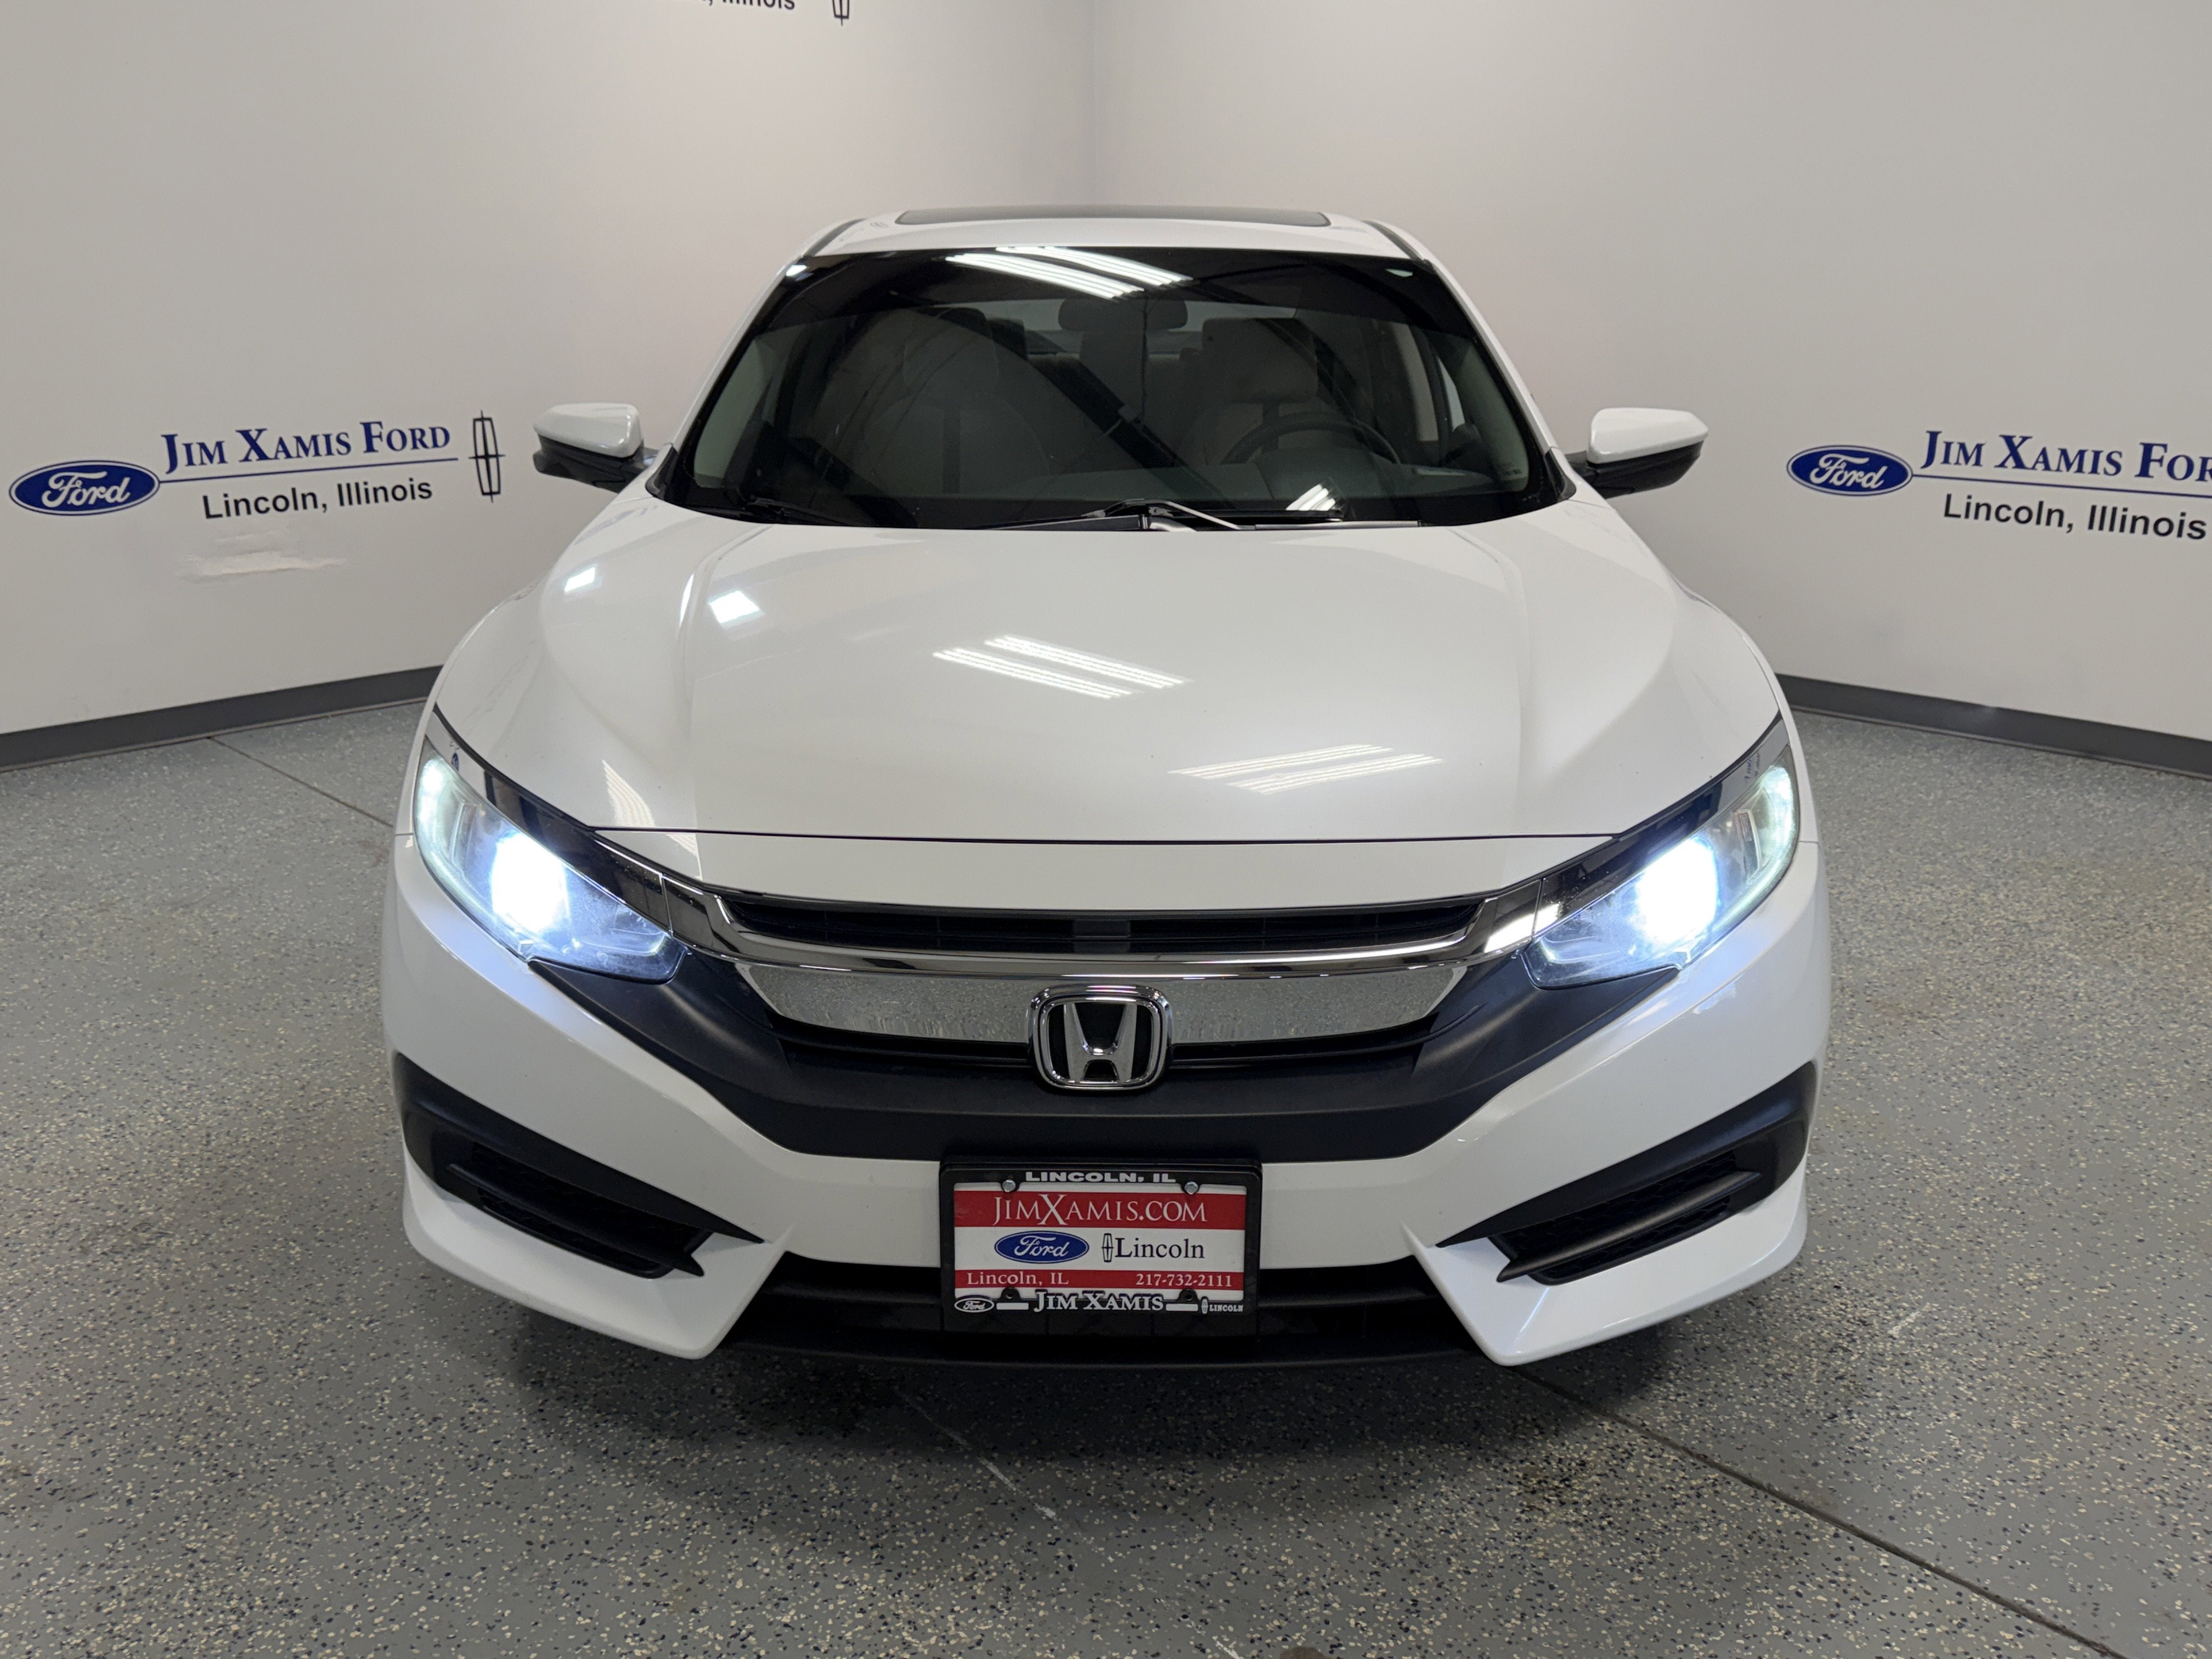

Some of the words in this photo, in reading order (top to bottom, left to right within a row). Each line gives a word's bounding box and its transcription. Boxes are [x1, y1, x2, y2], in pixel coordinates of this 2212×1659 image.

[161, 433, 228, 475] JIM
[236, 428, 352, 462] XAMIS
[359, 421, 450, 453] FORD
[1920, 430, 1985, 469] JIM
[1994, 435, 2123, 476] XAMIS
[2134, 442, 2212, 483] FOR
[202, 487, 328, 519] Lincoln,
[337, 477, 433, 507] Illinois
[1943, 493, 2074, 533] Lincoln,
[2087, 505, 2207, 540] Illinois
[1025, 1171, 1145, 1183] LINCOLN,
[1153, 1173, 1176, 1183] IL
[992, 1194, 1208, 1226] JIMXAMIS.COM
[1115, 1237, 1205, 1259] Lincoln
[967, 1271, 1042, 1286] Lincoln,
[1050, 1272, 1069, 1285] IL
[1135, 1273, 1232, 1287] 217-732-2111
[1033, 1291, 1079, 1312] JIM
[1082, 1293, 1164, 1311] XAMIS
[1209, 1304, 1244, 1312] LINCOLN
